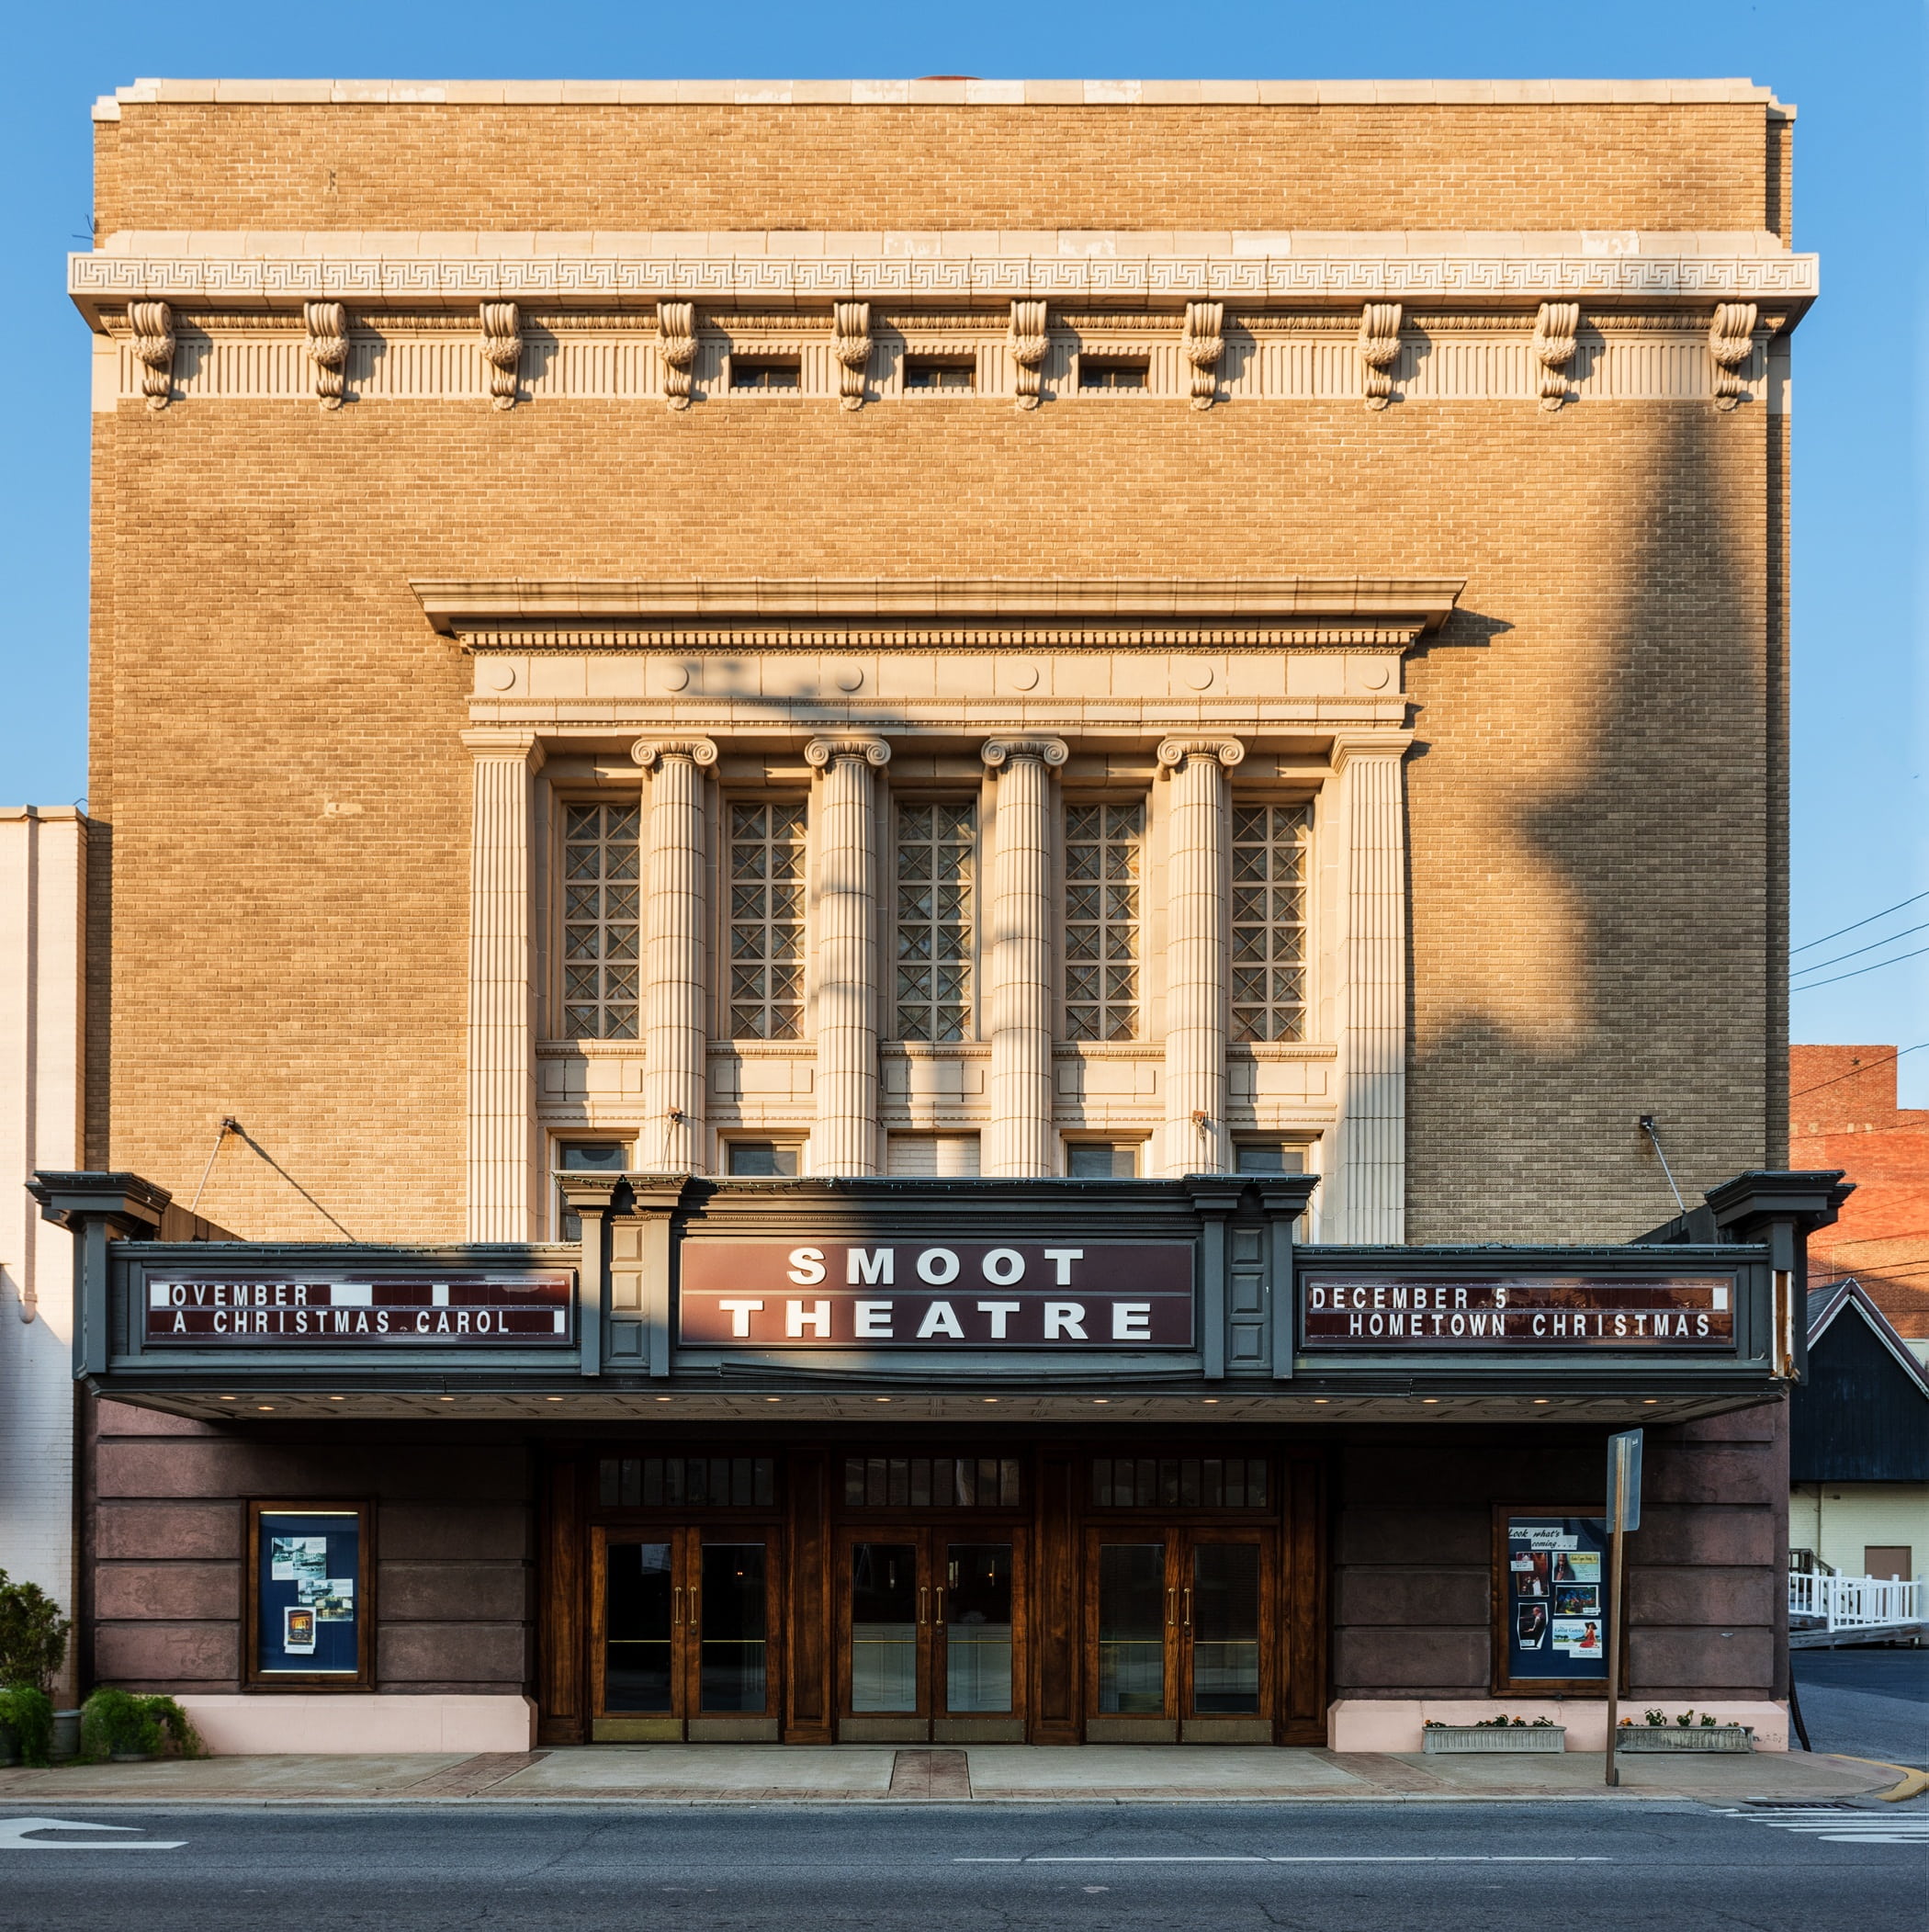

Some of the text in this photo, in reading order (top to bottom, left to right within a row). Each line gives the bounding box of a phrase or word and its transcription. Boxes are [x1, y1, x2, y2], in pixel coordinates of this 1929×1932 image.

[785, 1247, 1084, 1285] SMOOT
[172, 1284, 307, 1307] OVEMBER
[1312, 1286, 1506, 1309] DECEMBER 5
[173, 1310, 509, 1334] A CHRISTMAS CAROL
[718, 1299, 1151, 1340] THEATRE
[1349, 1313, 1709, 1337] HOMETOWN CHRISTMAS
[1508, 1529, 1561, 1539] Look what's
